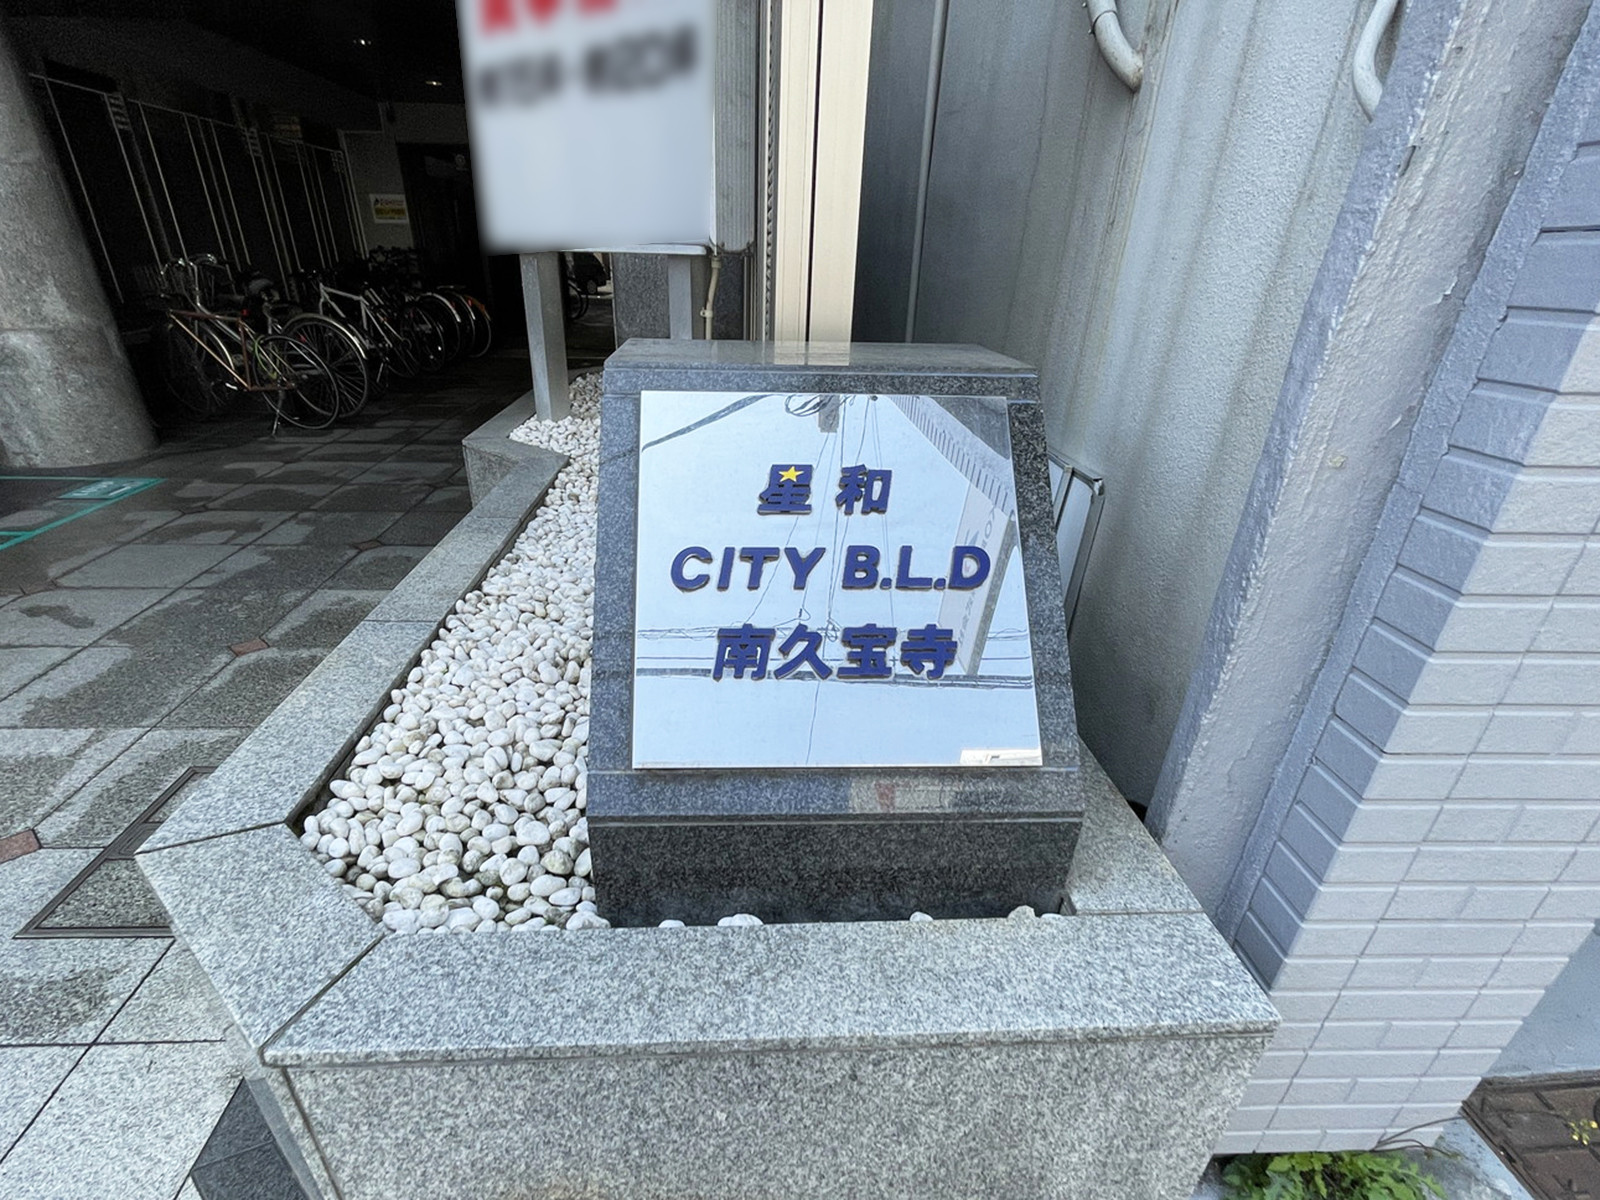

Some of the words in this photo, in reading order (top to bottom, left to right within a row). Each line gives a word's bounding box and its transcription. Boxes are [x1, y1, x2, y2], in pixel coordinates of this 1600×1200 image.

[670, 546, 826, 591] CITY
[842, 545, 991, 591] B.L.D
[713, 624, 958, 681] 南久宝寺
